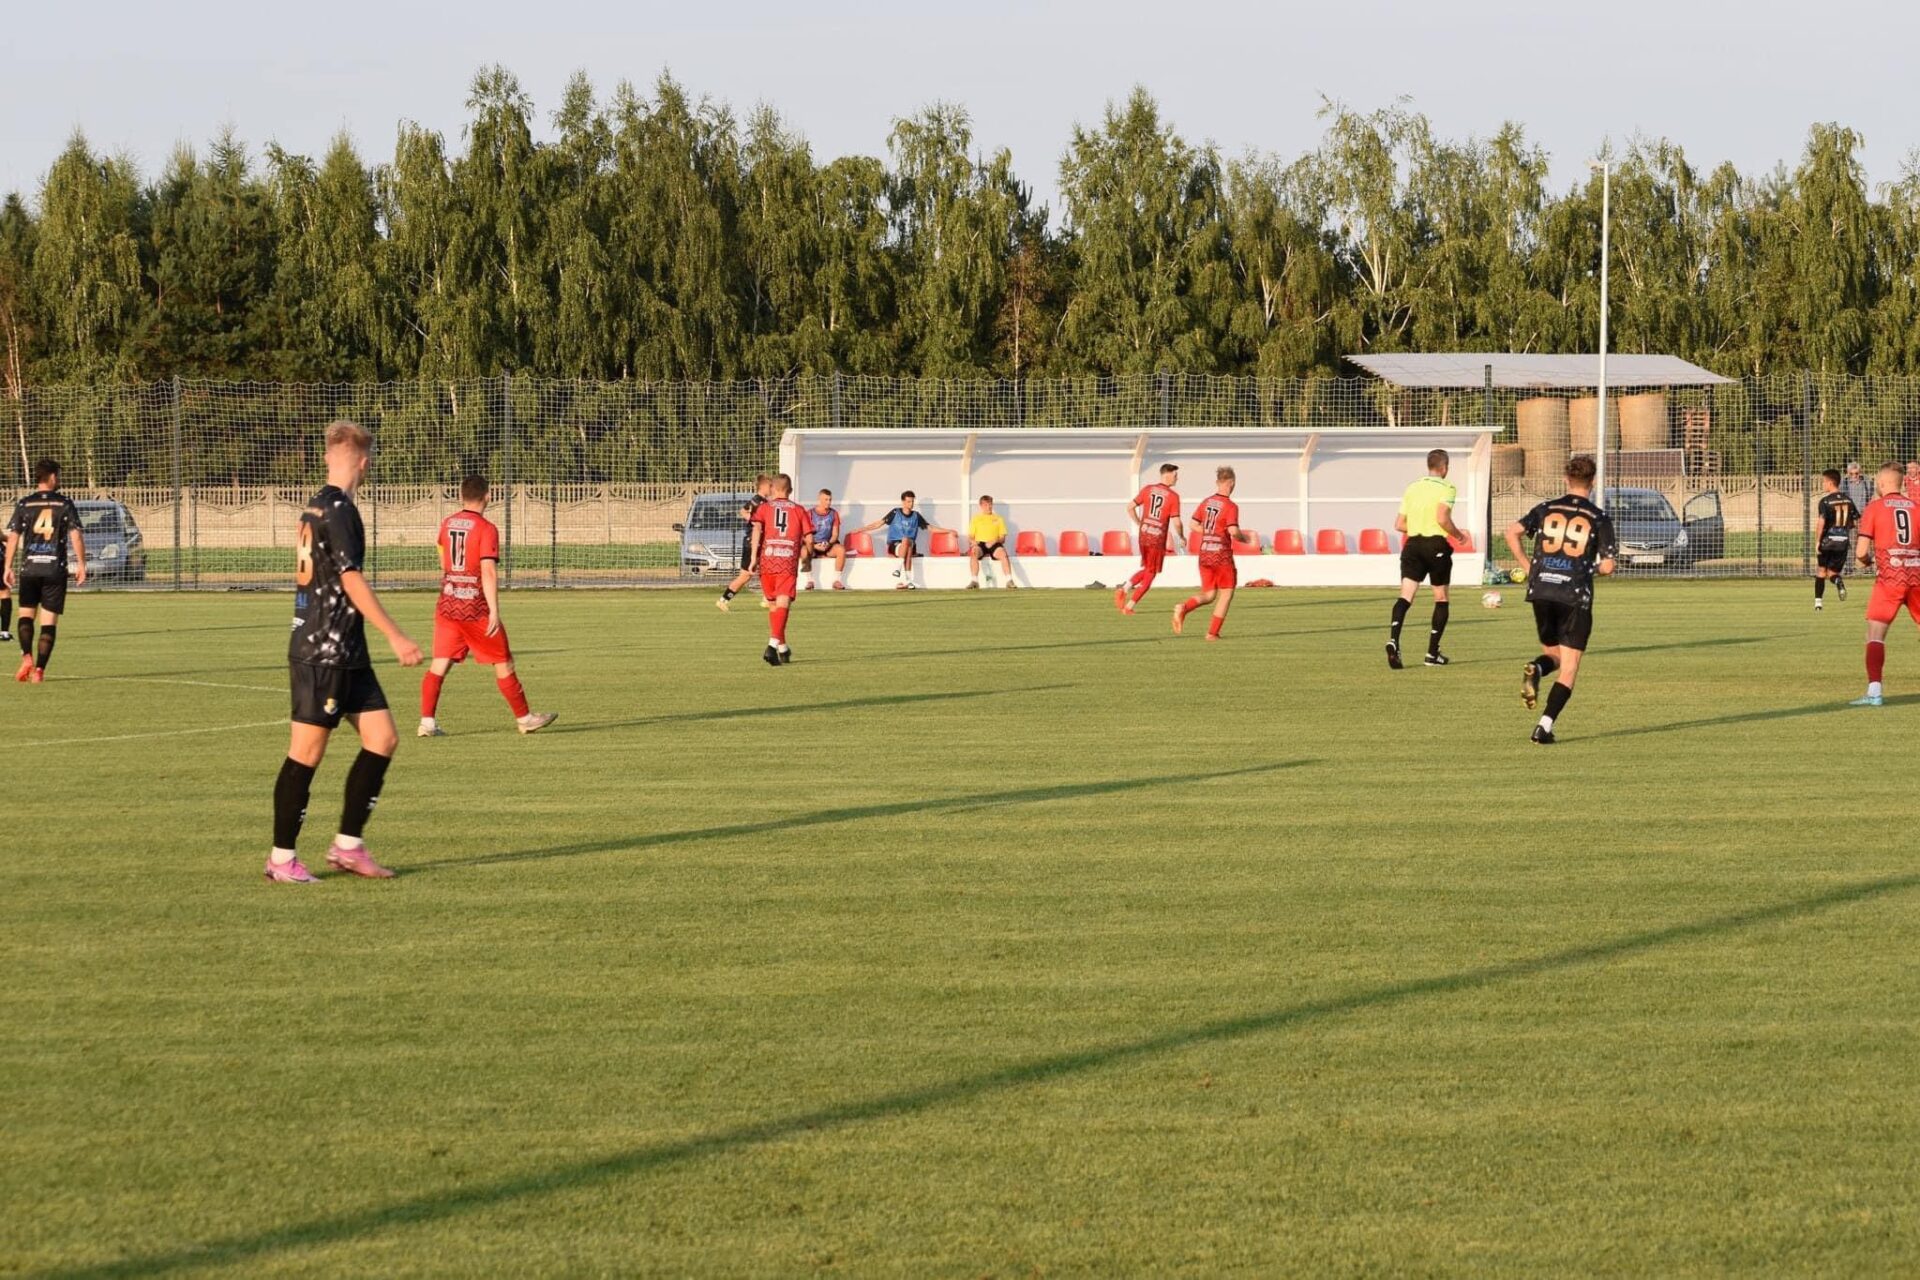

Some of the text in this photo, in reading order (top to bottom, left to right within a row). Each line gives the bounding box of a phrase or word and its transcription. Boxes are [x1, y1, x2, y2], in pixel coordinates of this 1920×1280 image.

[775, 507, 787, 534] 4
[1150, 493, 1164, 519] 12
[33, 508, 54, 541] 4
[1542, 512, 1591, 557] 99
[1895, 509, 1910, 544] 9
